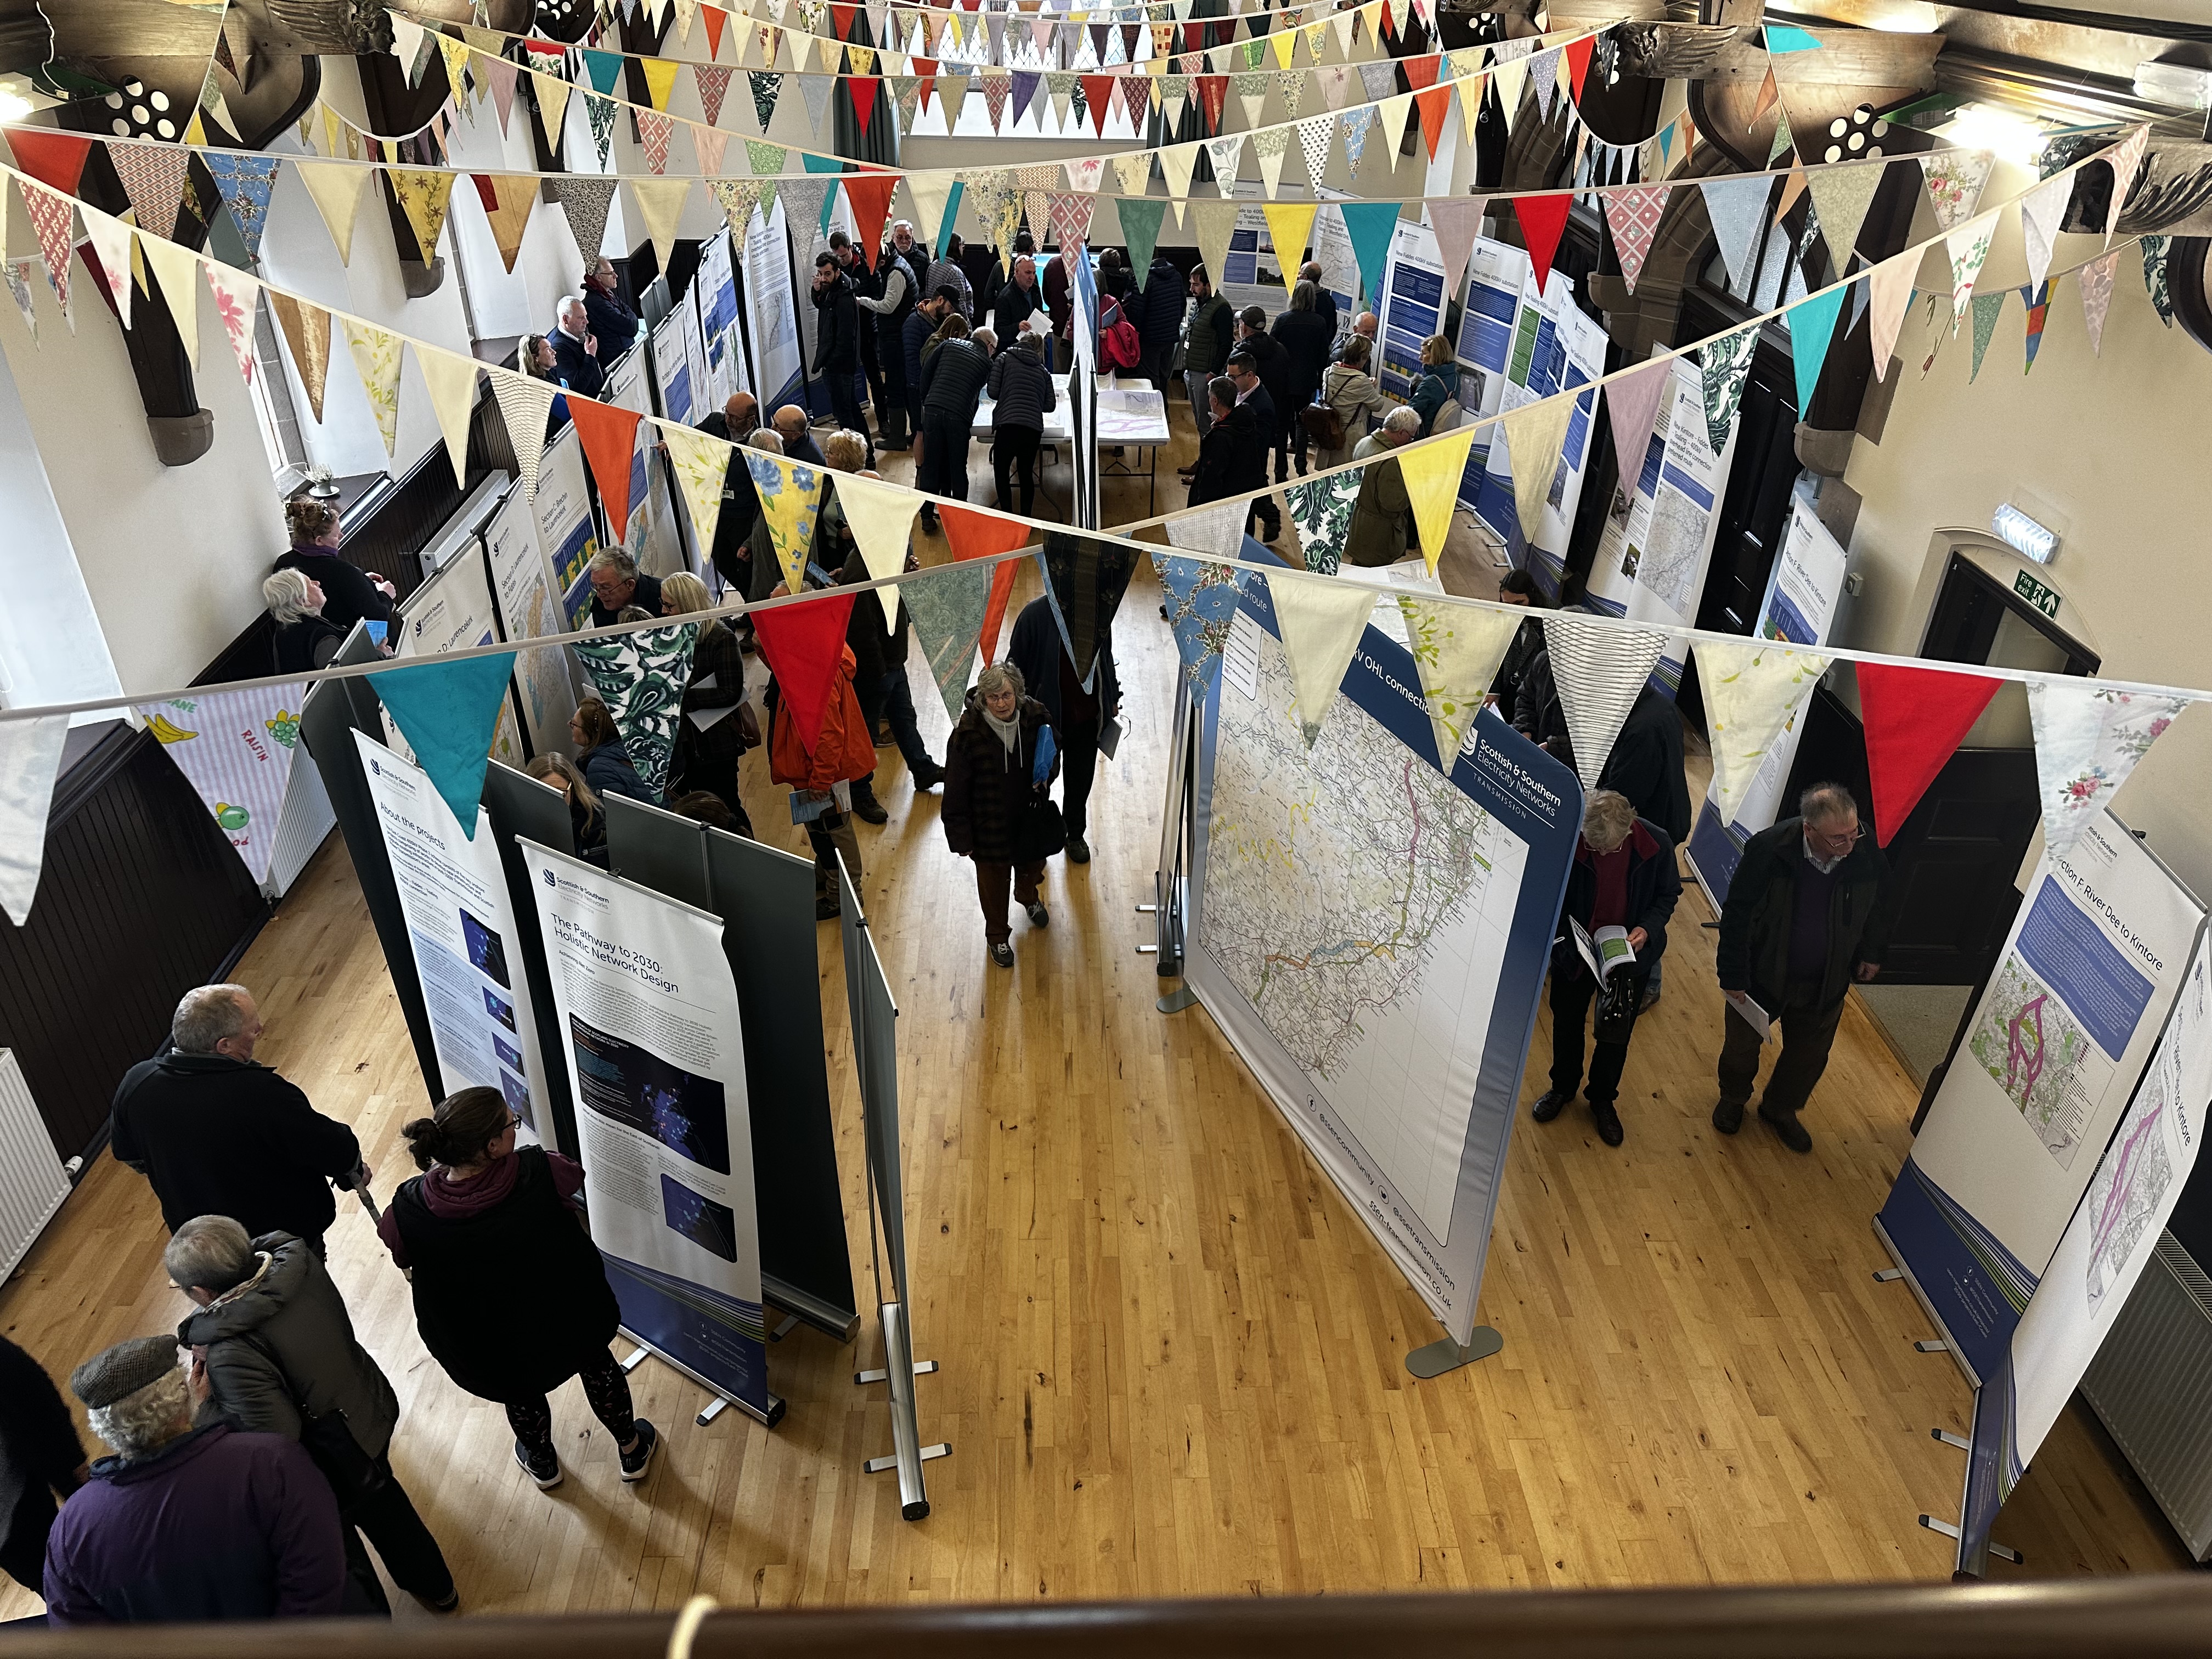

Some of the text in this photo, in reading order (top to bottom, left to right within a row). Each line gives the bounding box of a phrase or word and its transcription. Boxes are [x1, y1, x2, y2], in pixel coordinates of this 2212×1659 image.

[1681, 425, 1694, 439] Kintore
[1697, 436, 1709, 450] Fiddes
[1692, 453, 1712, 472] connection
[541, 508, 554, 524] Section
[544, 525, 549, 534] to
[2018, 584, 2029, 597] exit
[2020, 573, 2032, 588] Fire
[1249, 592, 1268, 612] route
[448, 614, 473, 647] Laurencekirk
[1365, 656, 1384, 680] OHL
[241, 729, 269, 762] RAISIN
[1477, 751, 1556, 817] Electricity Networks
[1480, 739, 1561, 806] Scottish & Southern
[1473, 772, 1527, 819] TRANSMISSION
[381, 802, 400, 822] About
[402, 816, 415, 831] the
[416, 825, 445, 850] projects
[2100, 837, 2117, 858] Southern
[556, 877, 579, 890] Scottish
[584, 888, 610, 904] Southern
[557, 883, 609, 909] Electricity Networks
[551, 912, 663, 974] The Pathway to 2030:
[2084, 885, 2106, 910] River
[2105, 906, 2120, 928] Dee
[2120, 923, 2130, 938] to
[2130, 934, 2163, 971] Kintore
[555, 927, 679, 993] Holistic Network Design
[586, 964, 595, 974] Zero
[2177, 1102, 2191, 1147] Kintore
[1319, 1113, 1375, 1186] @ssencommunity
[1369, 1200, 1452, 1310] ssen-transmission.co.uk
[1393, 1207, 1455, 1291] @ssetransmission
